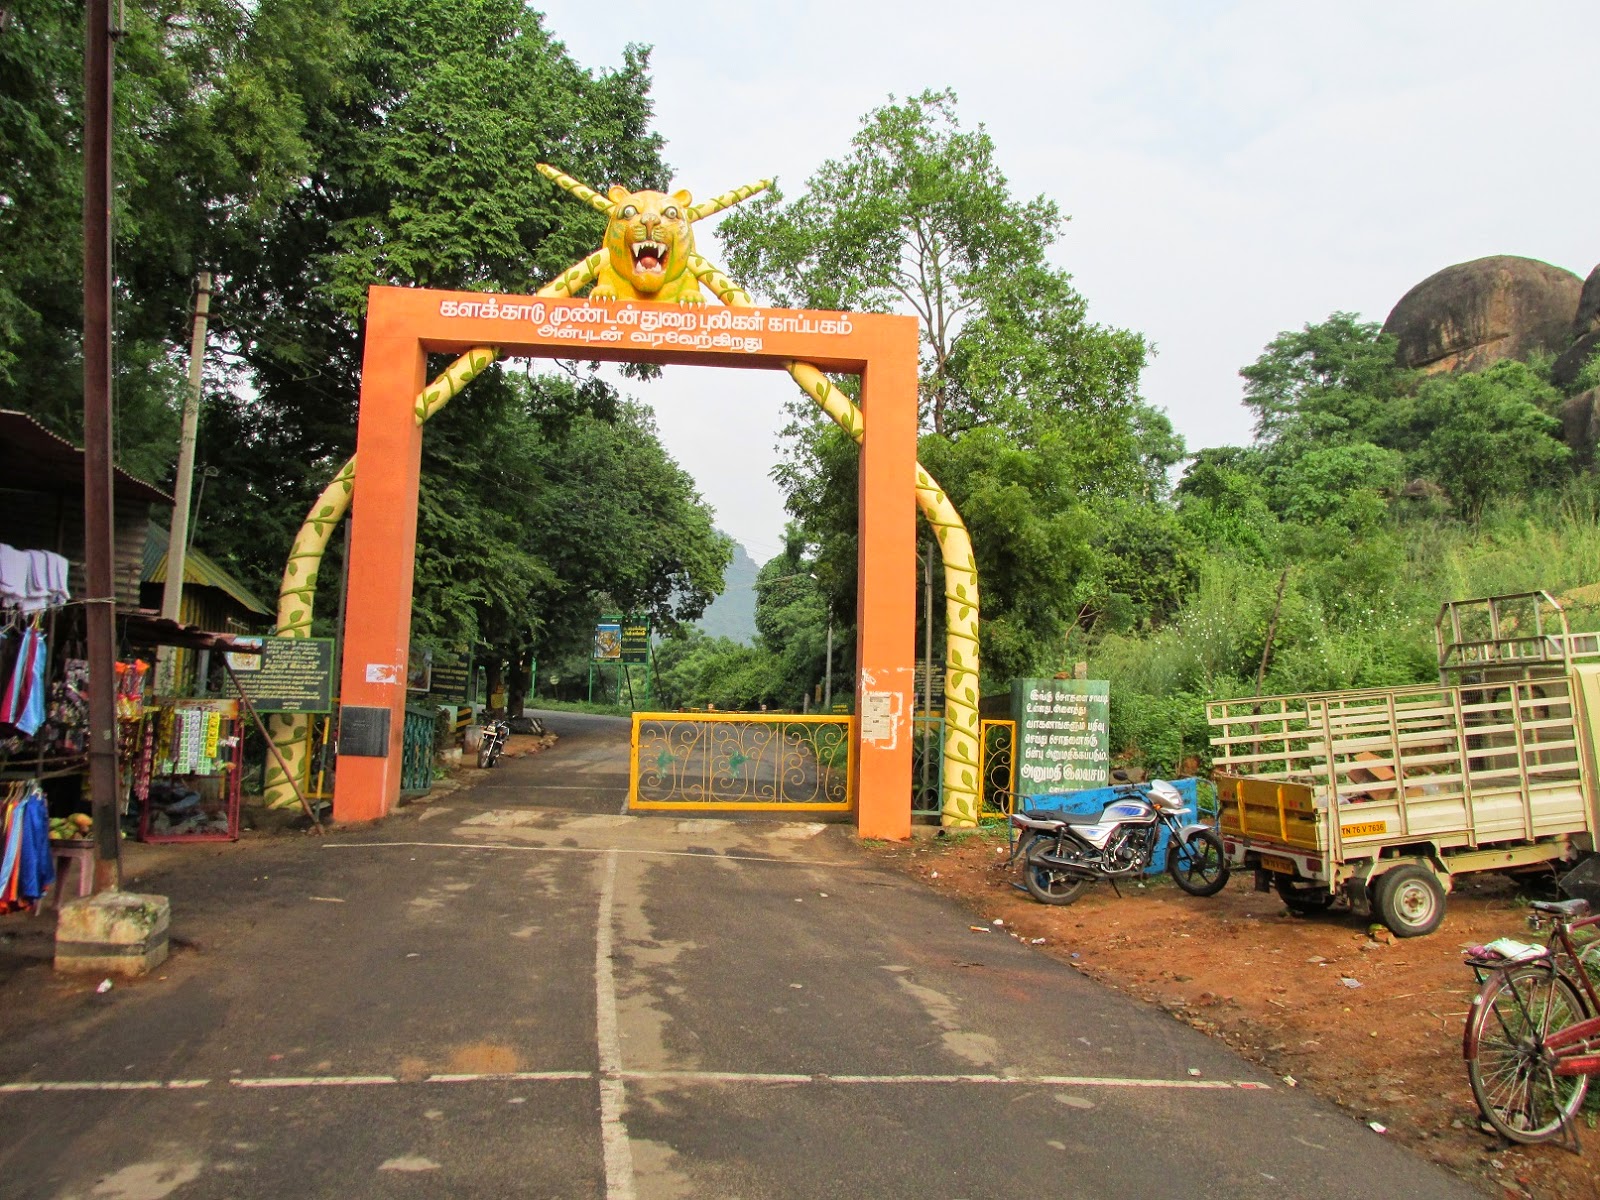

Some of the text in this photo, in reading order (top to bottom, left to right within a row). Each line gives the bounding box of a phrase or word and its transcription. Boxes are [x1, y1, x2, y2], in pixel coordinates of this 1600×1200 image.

[439, 297, 853, 335] களக்காடு முண்டன்துறை புலிகள் காப்பகம்
[537, 324, 763, 353] அன்புடன் வரவேற்கிறது
[1030, 689, 1053, 703] இங்கு
[1026, 717, 1105, 733] வாகனங்களும் பதிவு
[1021, 763, 1106, 783] அனுமதி இலவசம்
